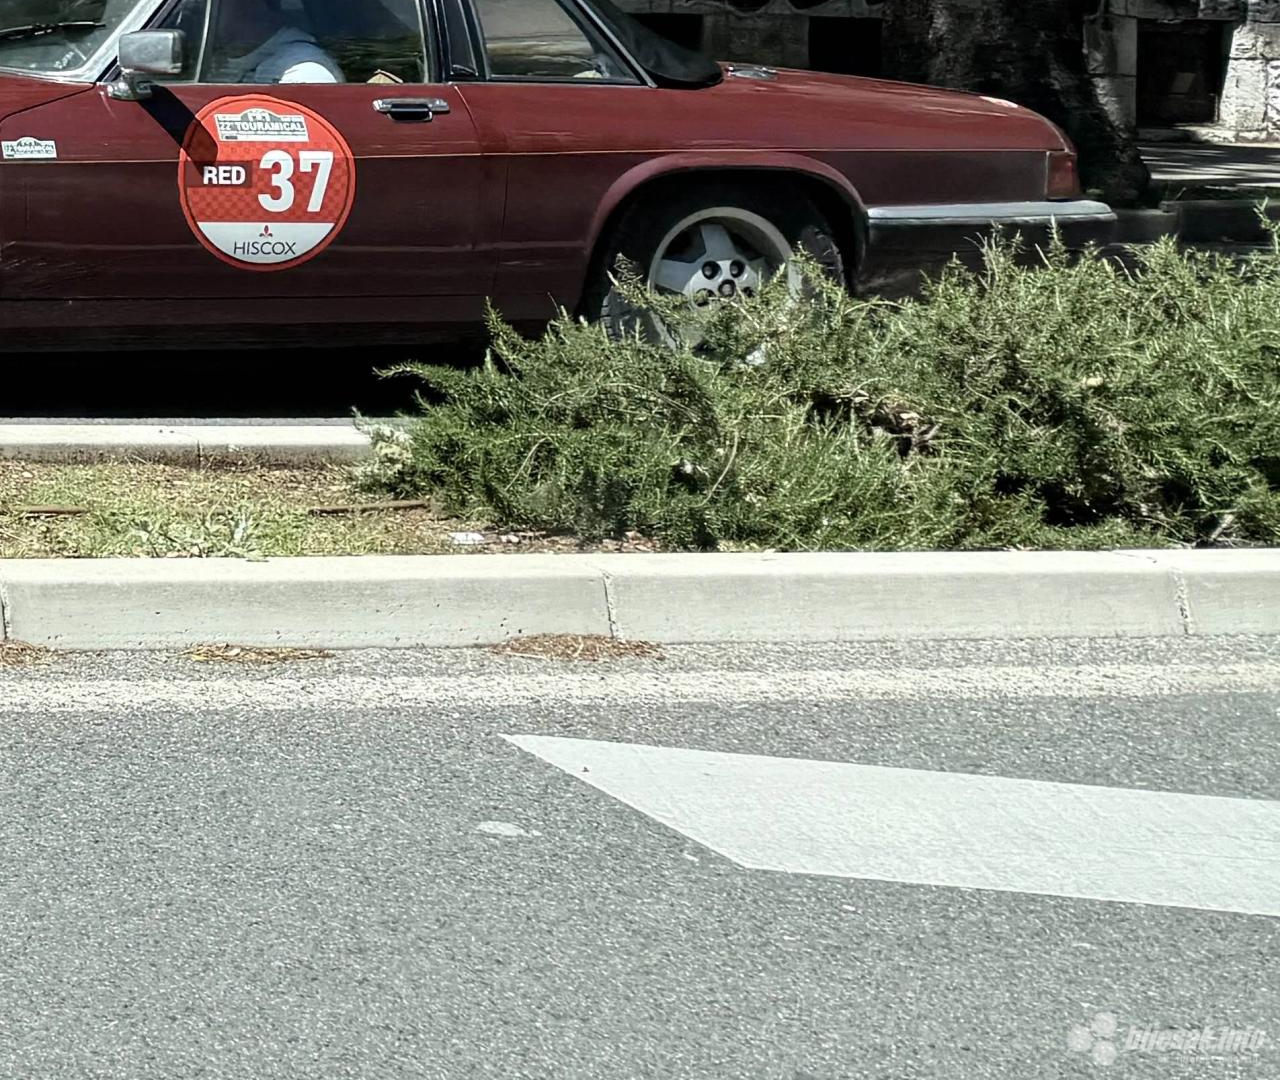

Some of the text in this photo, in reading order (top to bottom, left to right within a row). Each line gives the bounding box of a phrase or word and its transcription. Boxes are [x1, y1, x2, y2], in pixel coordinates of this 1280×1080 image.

[234, 121, 306, 132] TOURAMICAL
[203, 165, 246, 185] RED
[257, 149, 334, 213] 37
[233, 241, 297, 255] HISCOX
